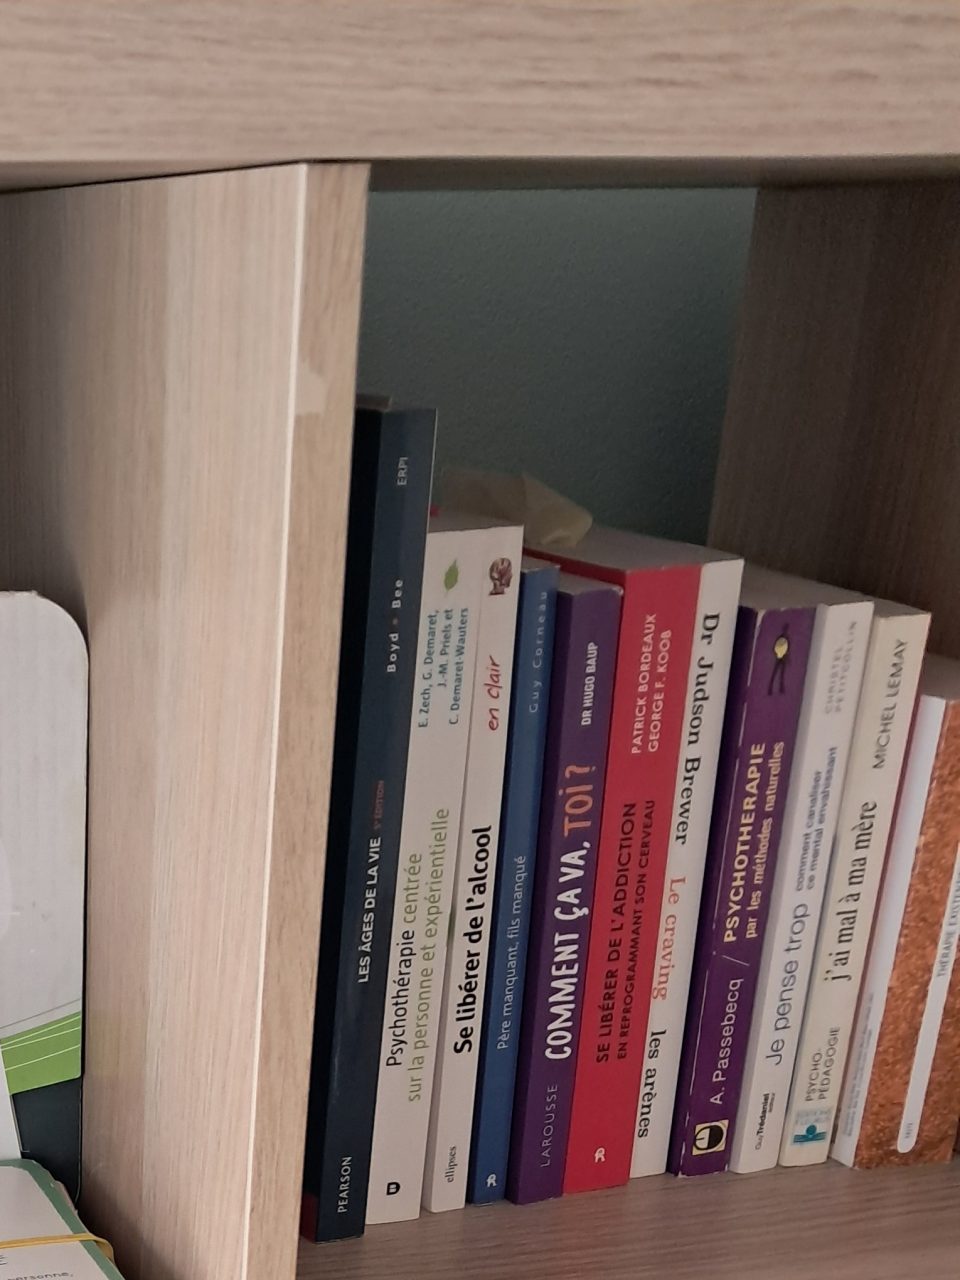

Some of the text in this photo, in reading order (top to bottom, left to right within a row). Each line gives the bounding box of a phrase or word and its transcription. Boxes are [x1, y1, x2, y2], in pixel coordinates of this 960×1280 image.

[397, 456, 409, 486] ERPI
[387, 579, 404, 673] Boyd Bee
[422, 610, 440, 666] Demaret,
[440, 623, 452, 661] Priels
[451, 607, 469, 710] Demaret-Wauters
[482, 655, 503, 698] clair
[533, 591, 548, 669] Corneau
[583, 642, 598, 707] HUGO BAUP
[631, 613, 657, 754] PATRICK BORDEAUX
[648, 629, 672, 753] GEORGE KOOB
[675, 613, 720, 846] Dr Judson Brewer
[872, 638, 909, 770] MICHEL LEMAY
[745, 741, 784, 939] par les méthodes naturelles
[795, 771, 823, 891] comment canaliser
[815, 747, 837, 827] envahissant
[555, 889, 588, 922] ÇA
[558, 841, 591, 887] VA,
[824, 800, 878, 981] j'ai mal ma mère
[358, 909, 376, 983] LES ÂGES
[386, 852, 422, 1067] Psychothérapie centrée
[409, 808, 449, 1102] sur personne et expérientielle
[454, 825, 492, 1054] Se libérer de l'alcool
[497, 855, 527, 1050] Père manquant, fils manqué
[596, 803, 637, 1064] SE LIBÉRER DE L'ADDICTION
[618, 800, 656, 1059] EN REPROGRAMMANT SON CERVEAU
[652, 875, 686, 1000] Le craving
[544, 932, 580, 1060] COMMENT
[712, 978, 744, 1083] Passebecq
[765, 903, 810, 1065] Je pense trop
[637, 1028, 667, 1139] les arènes
[819, 1026, 840, 1100] PÉDAGOGIE
[445, 1145, 458, 1183] ellipses
[540, 1084, 558, 1168] LAROUSSE
[338, 1155, 352, 1213] PEARSON
